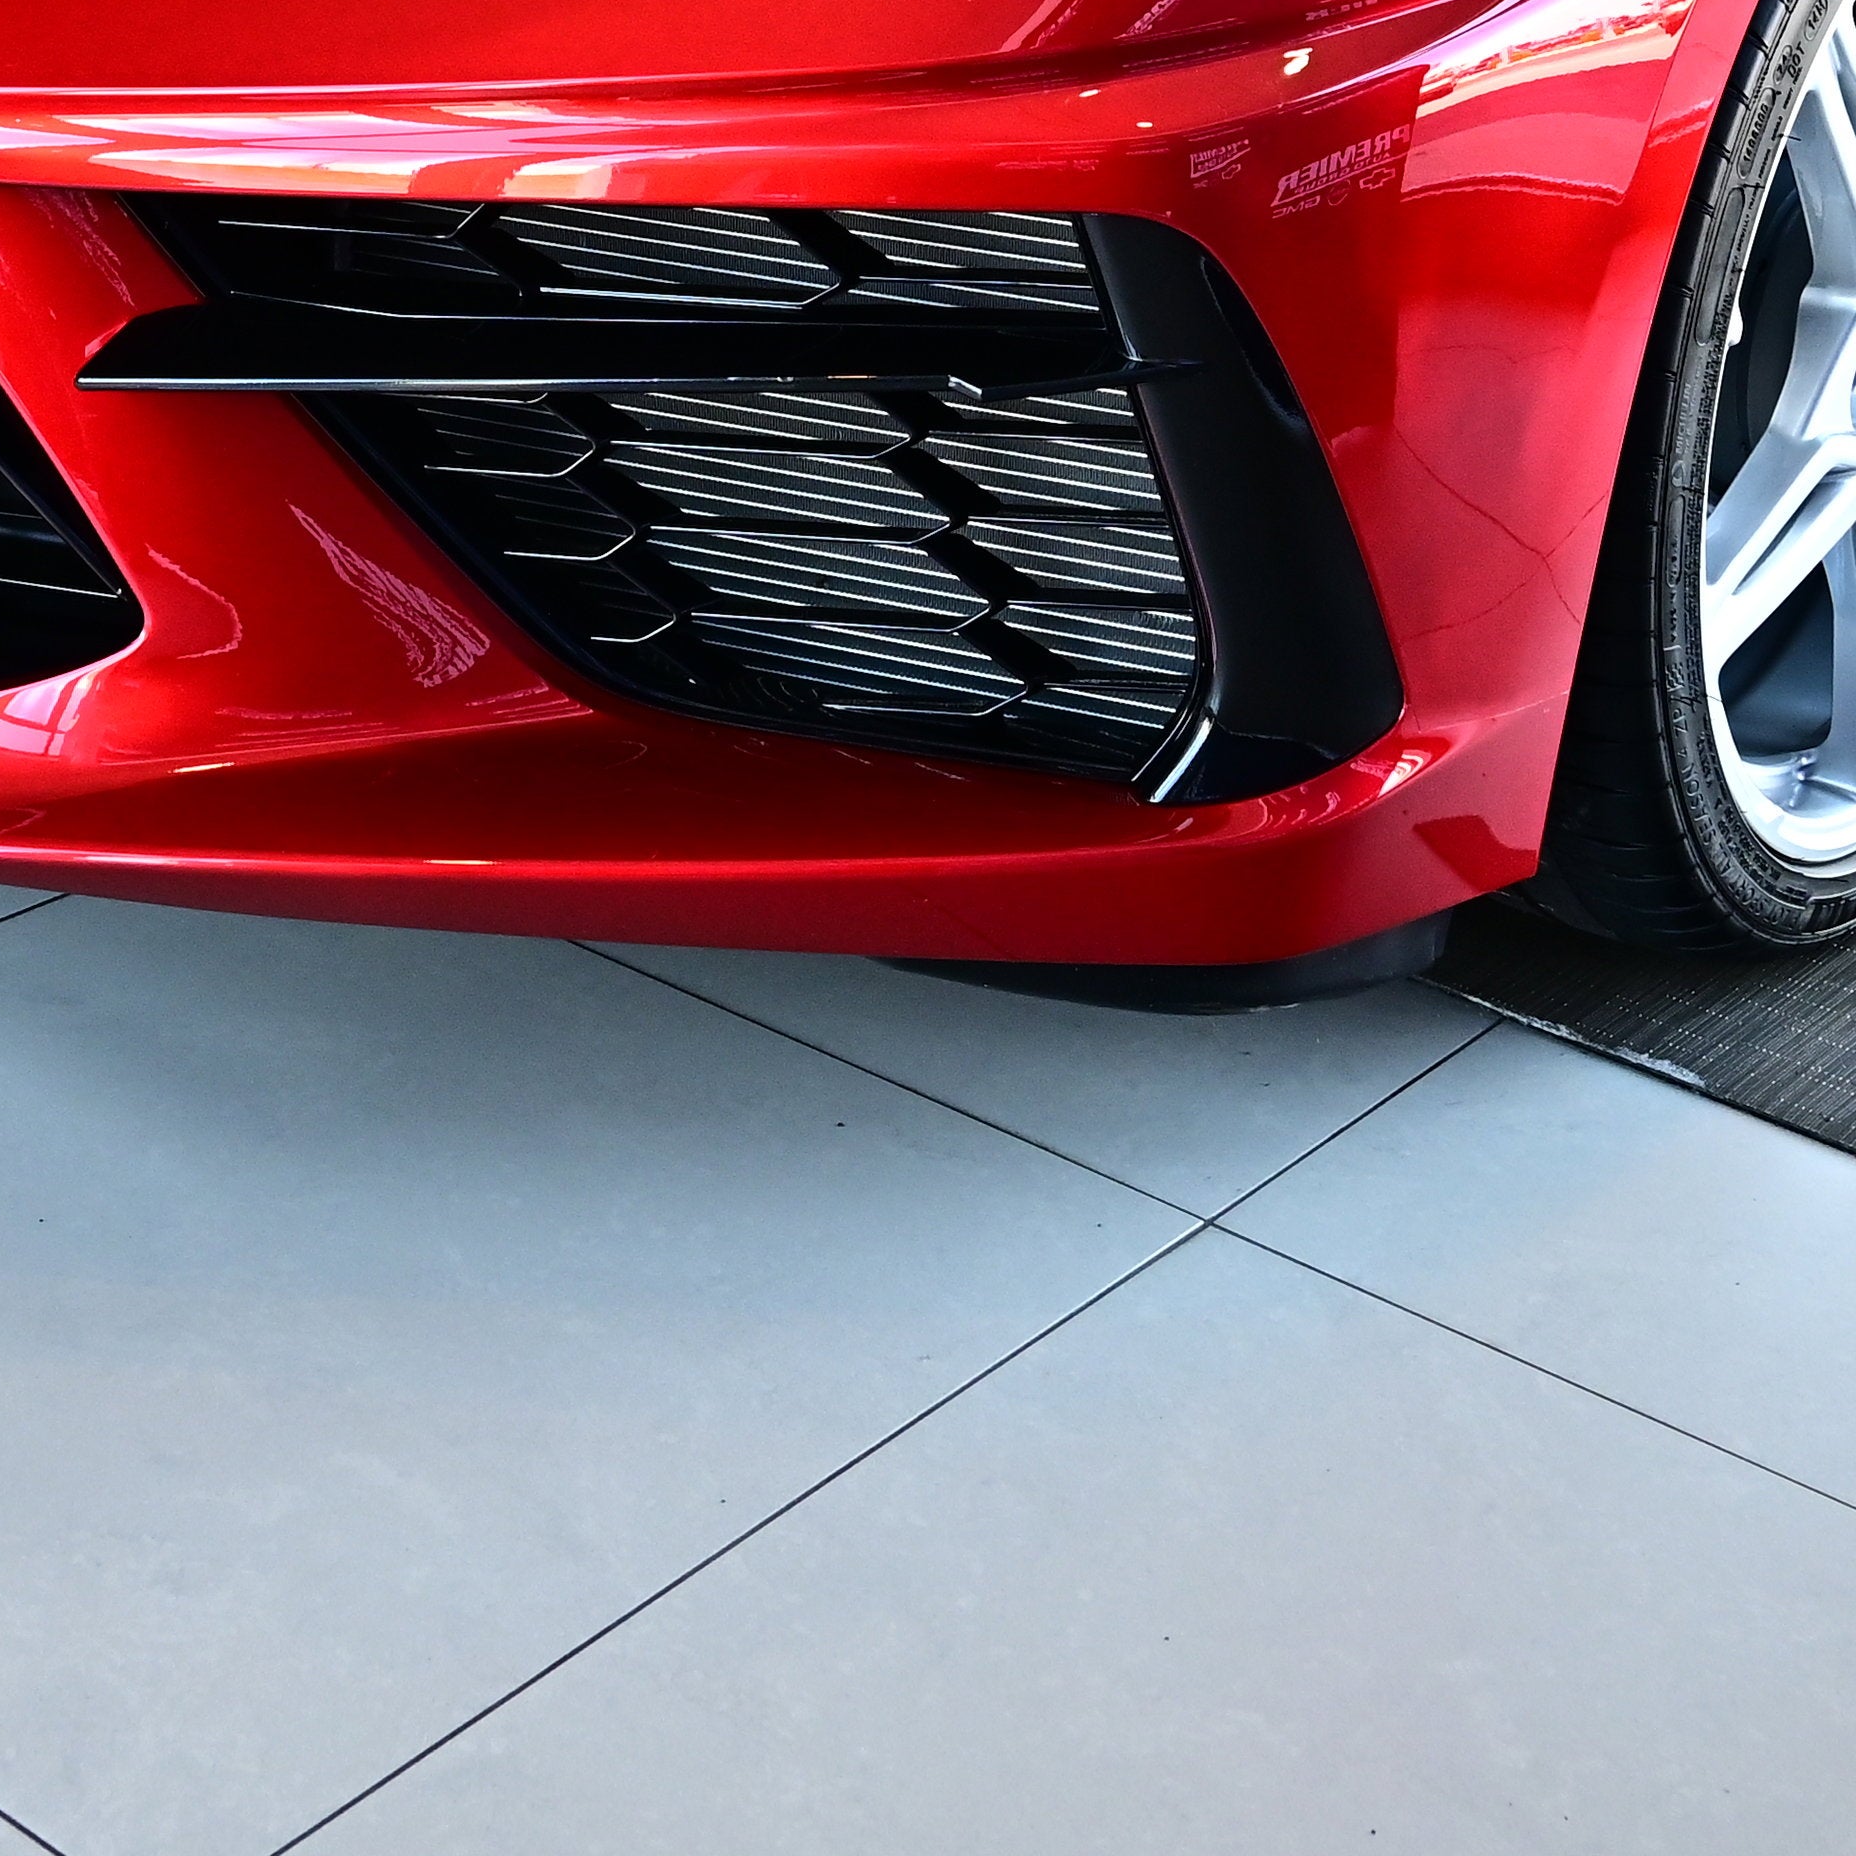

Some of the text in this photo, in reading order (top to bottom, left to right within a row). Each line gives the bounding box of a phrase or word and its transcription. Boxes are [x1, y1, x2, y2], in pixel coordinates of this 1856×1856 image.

[1787, 41, 1806, 79] DOT
[1674, 383, 1692, 456] MICHELIN
[1673, 708, 1689, 738] ZP
[1683, 763, 1717, 846] SEASON
